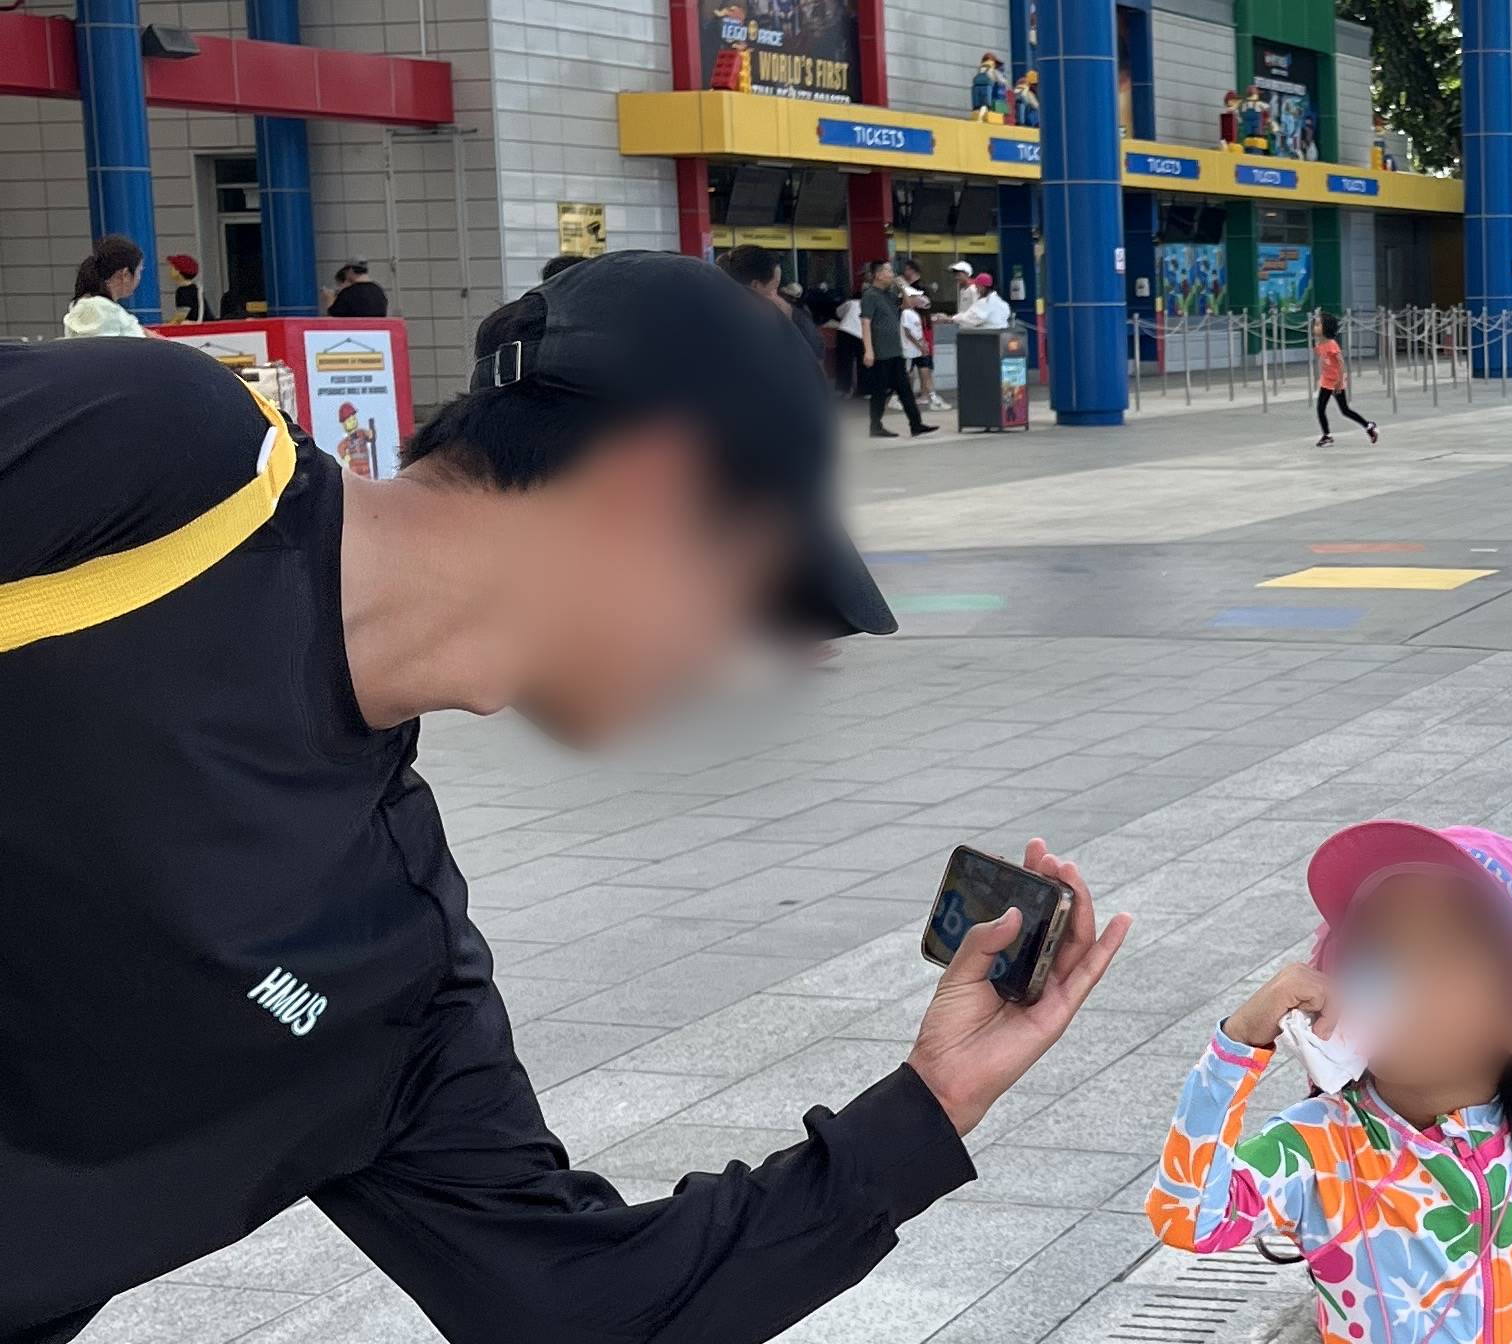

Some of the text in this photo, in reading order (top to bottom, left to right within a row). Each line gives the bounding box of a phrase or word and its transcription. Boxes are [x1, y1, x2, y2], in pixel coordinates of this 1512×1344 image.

[758, 50, 849, 91] WORLD'S FIRST
[853, 125, 905, 148] TICKETS
[1017, 143, 1041, 161] TICK
